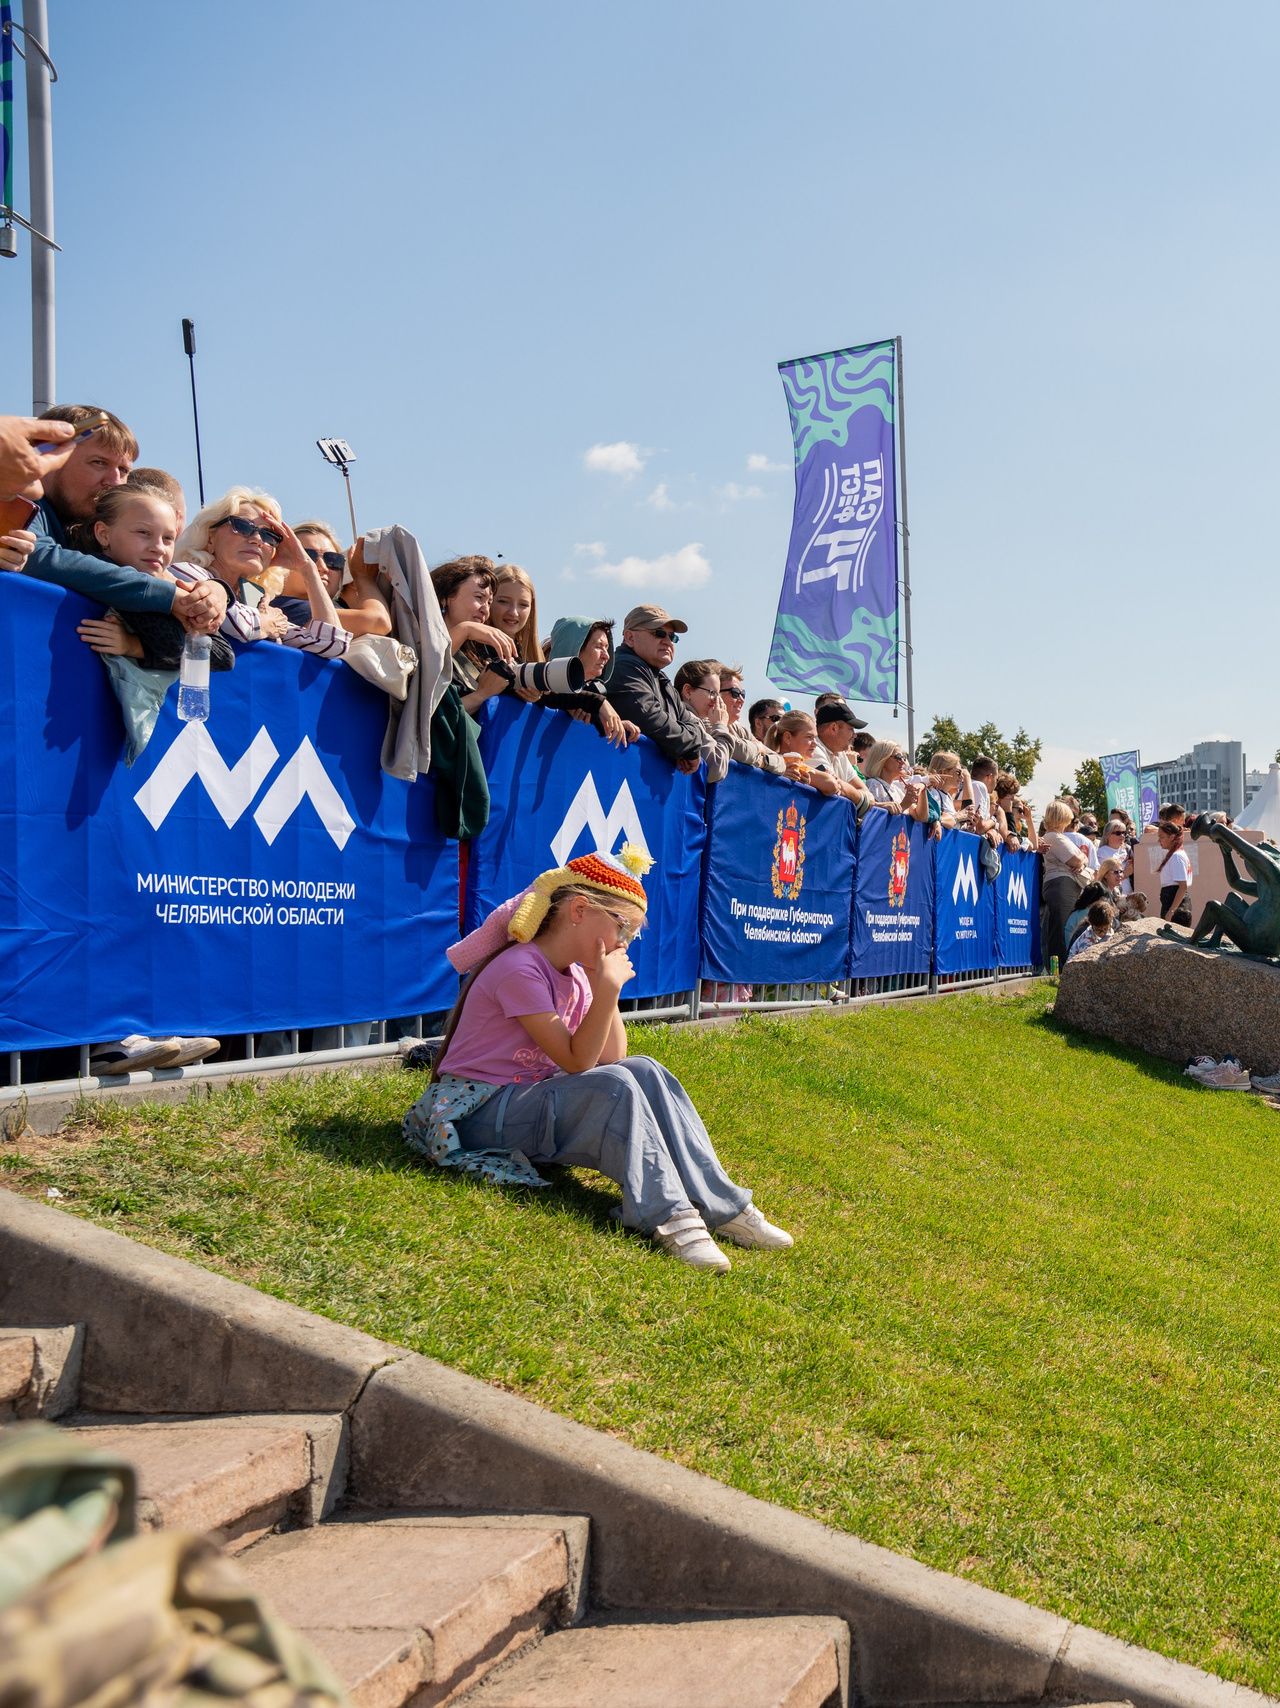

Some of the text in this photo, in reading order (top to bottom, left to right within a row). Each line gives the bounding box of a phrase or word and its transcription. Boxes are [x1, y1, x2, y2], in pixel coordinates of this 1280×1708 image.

[137, 872, 356, 902] МИНИСТЕРСТВО МОЛОДЕЖИ
[156, 903, 345, 926] ЧЕЛЯБИНСКОЙ ОБЛАСТИ
[730, 897, 834, 928] При поддержке Губернатора
[744, 922, 822, 944] Челябинской области
